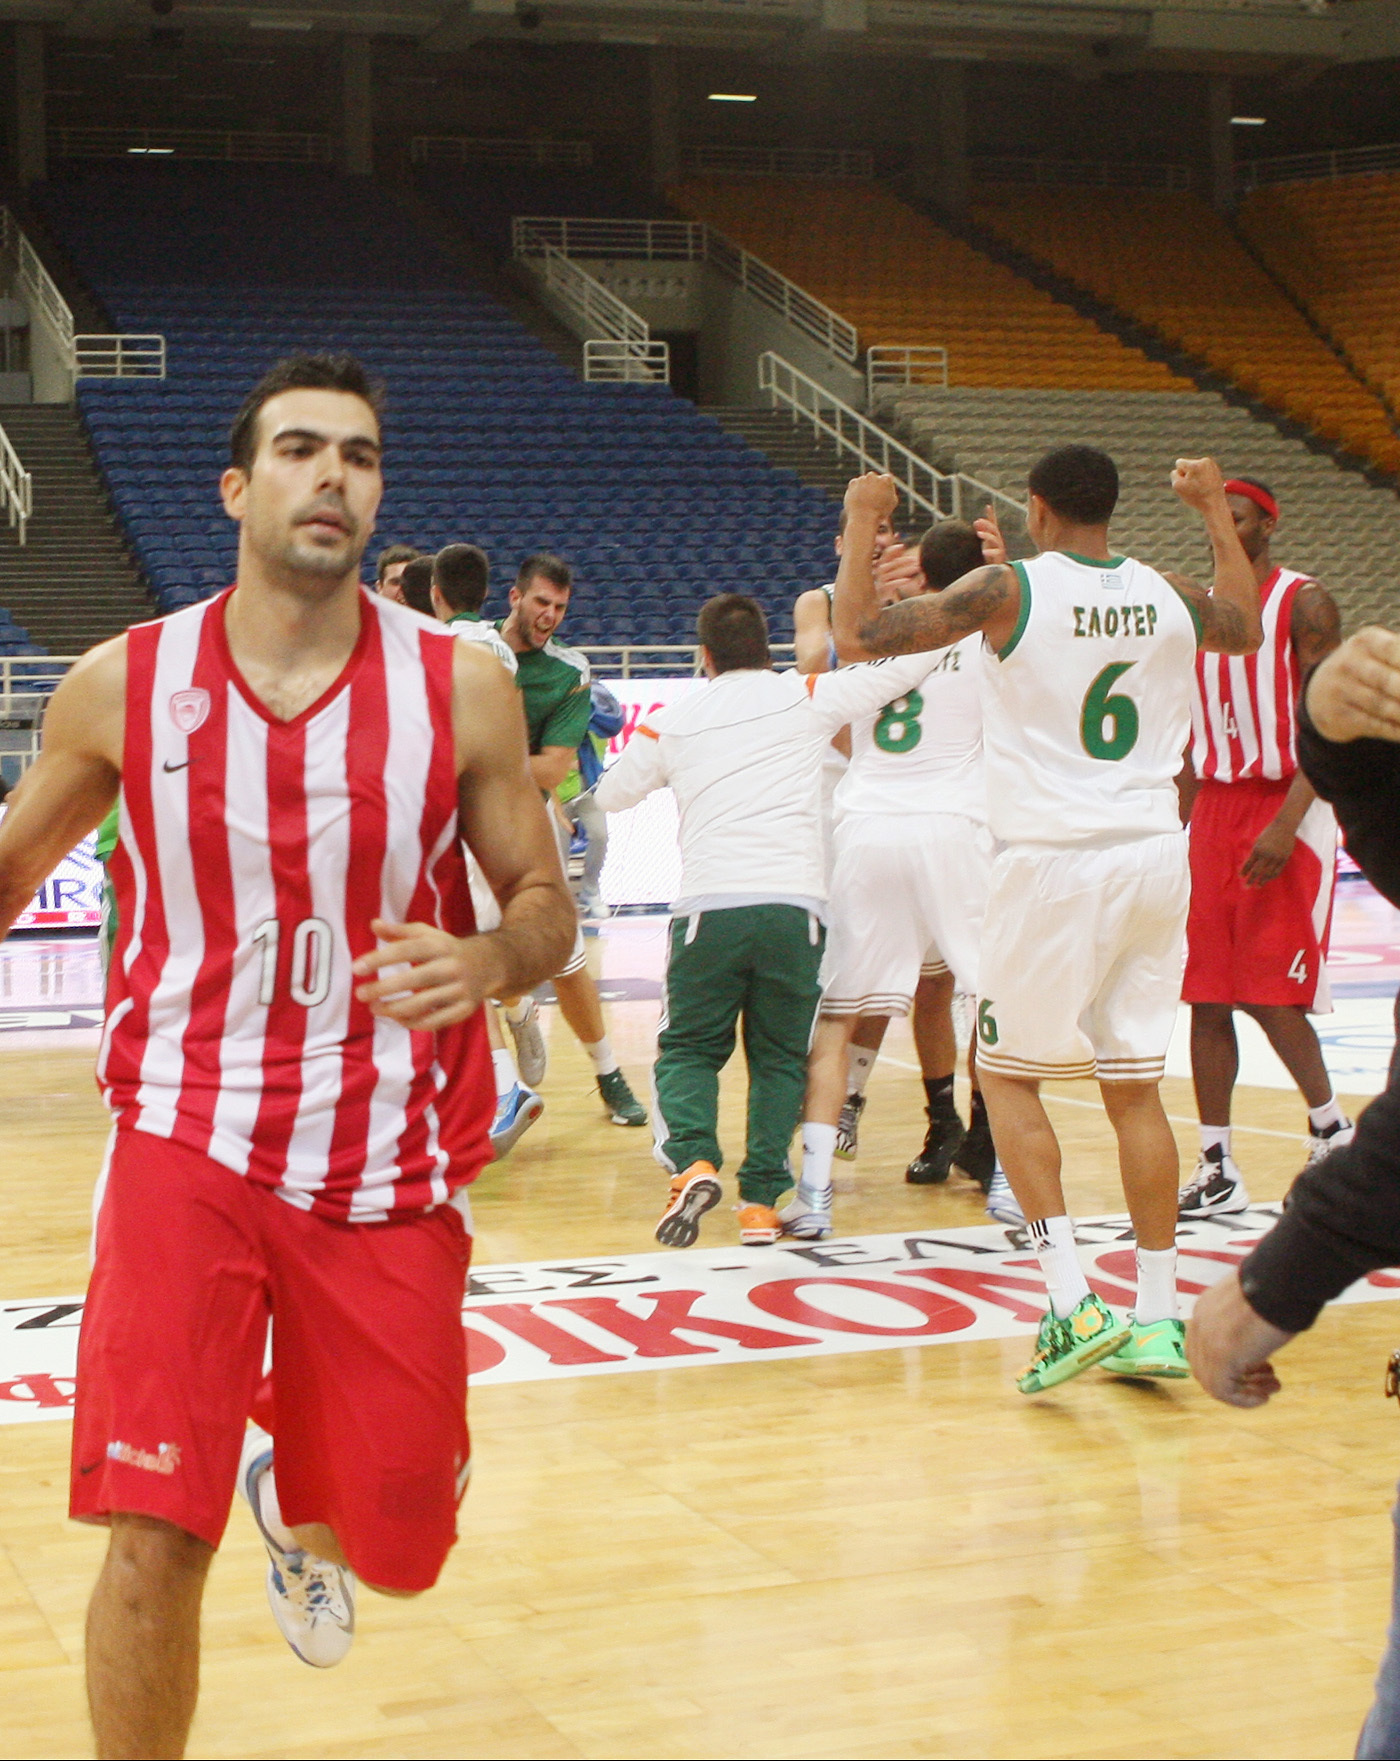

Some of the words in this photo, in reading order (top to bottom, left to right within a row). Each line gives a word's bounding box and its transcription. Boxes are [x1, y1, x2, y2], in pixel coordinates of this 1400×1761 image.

[1072, 603, 1158, 638] ΣΛΟΤΕΡ
[873, 687, 925, 755] 8
[1079, 660, 1140, 762] 6
[1222, 702, 1239, 739] 4
[251, 916, 335, 1008] 10
[1287, 949, 1308, 985] 4
[978, 997, 999, 1046] 6
